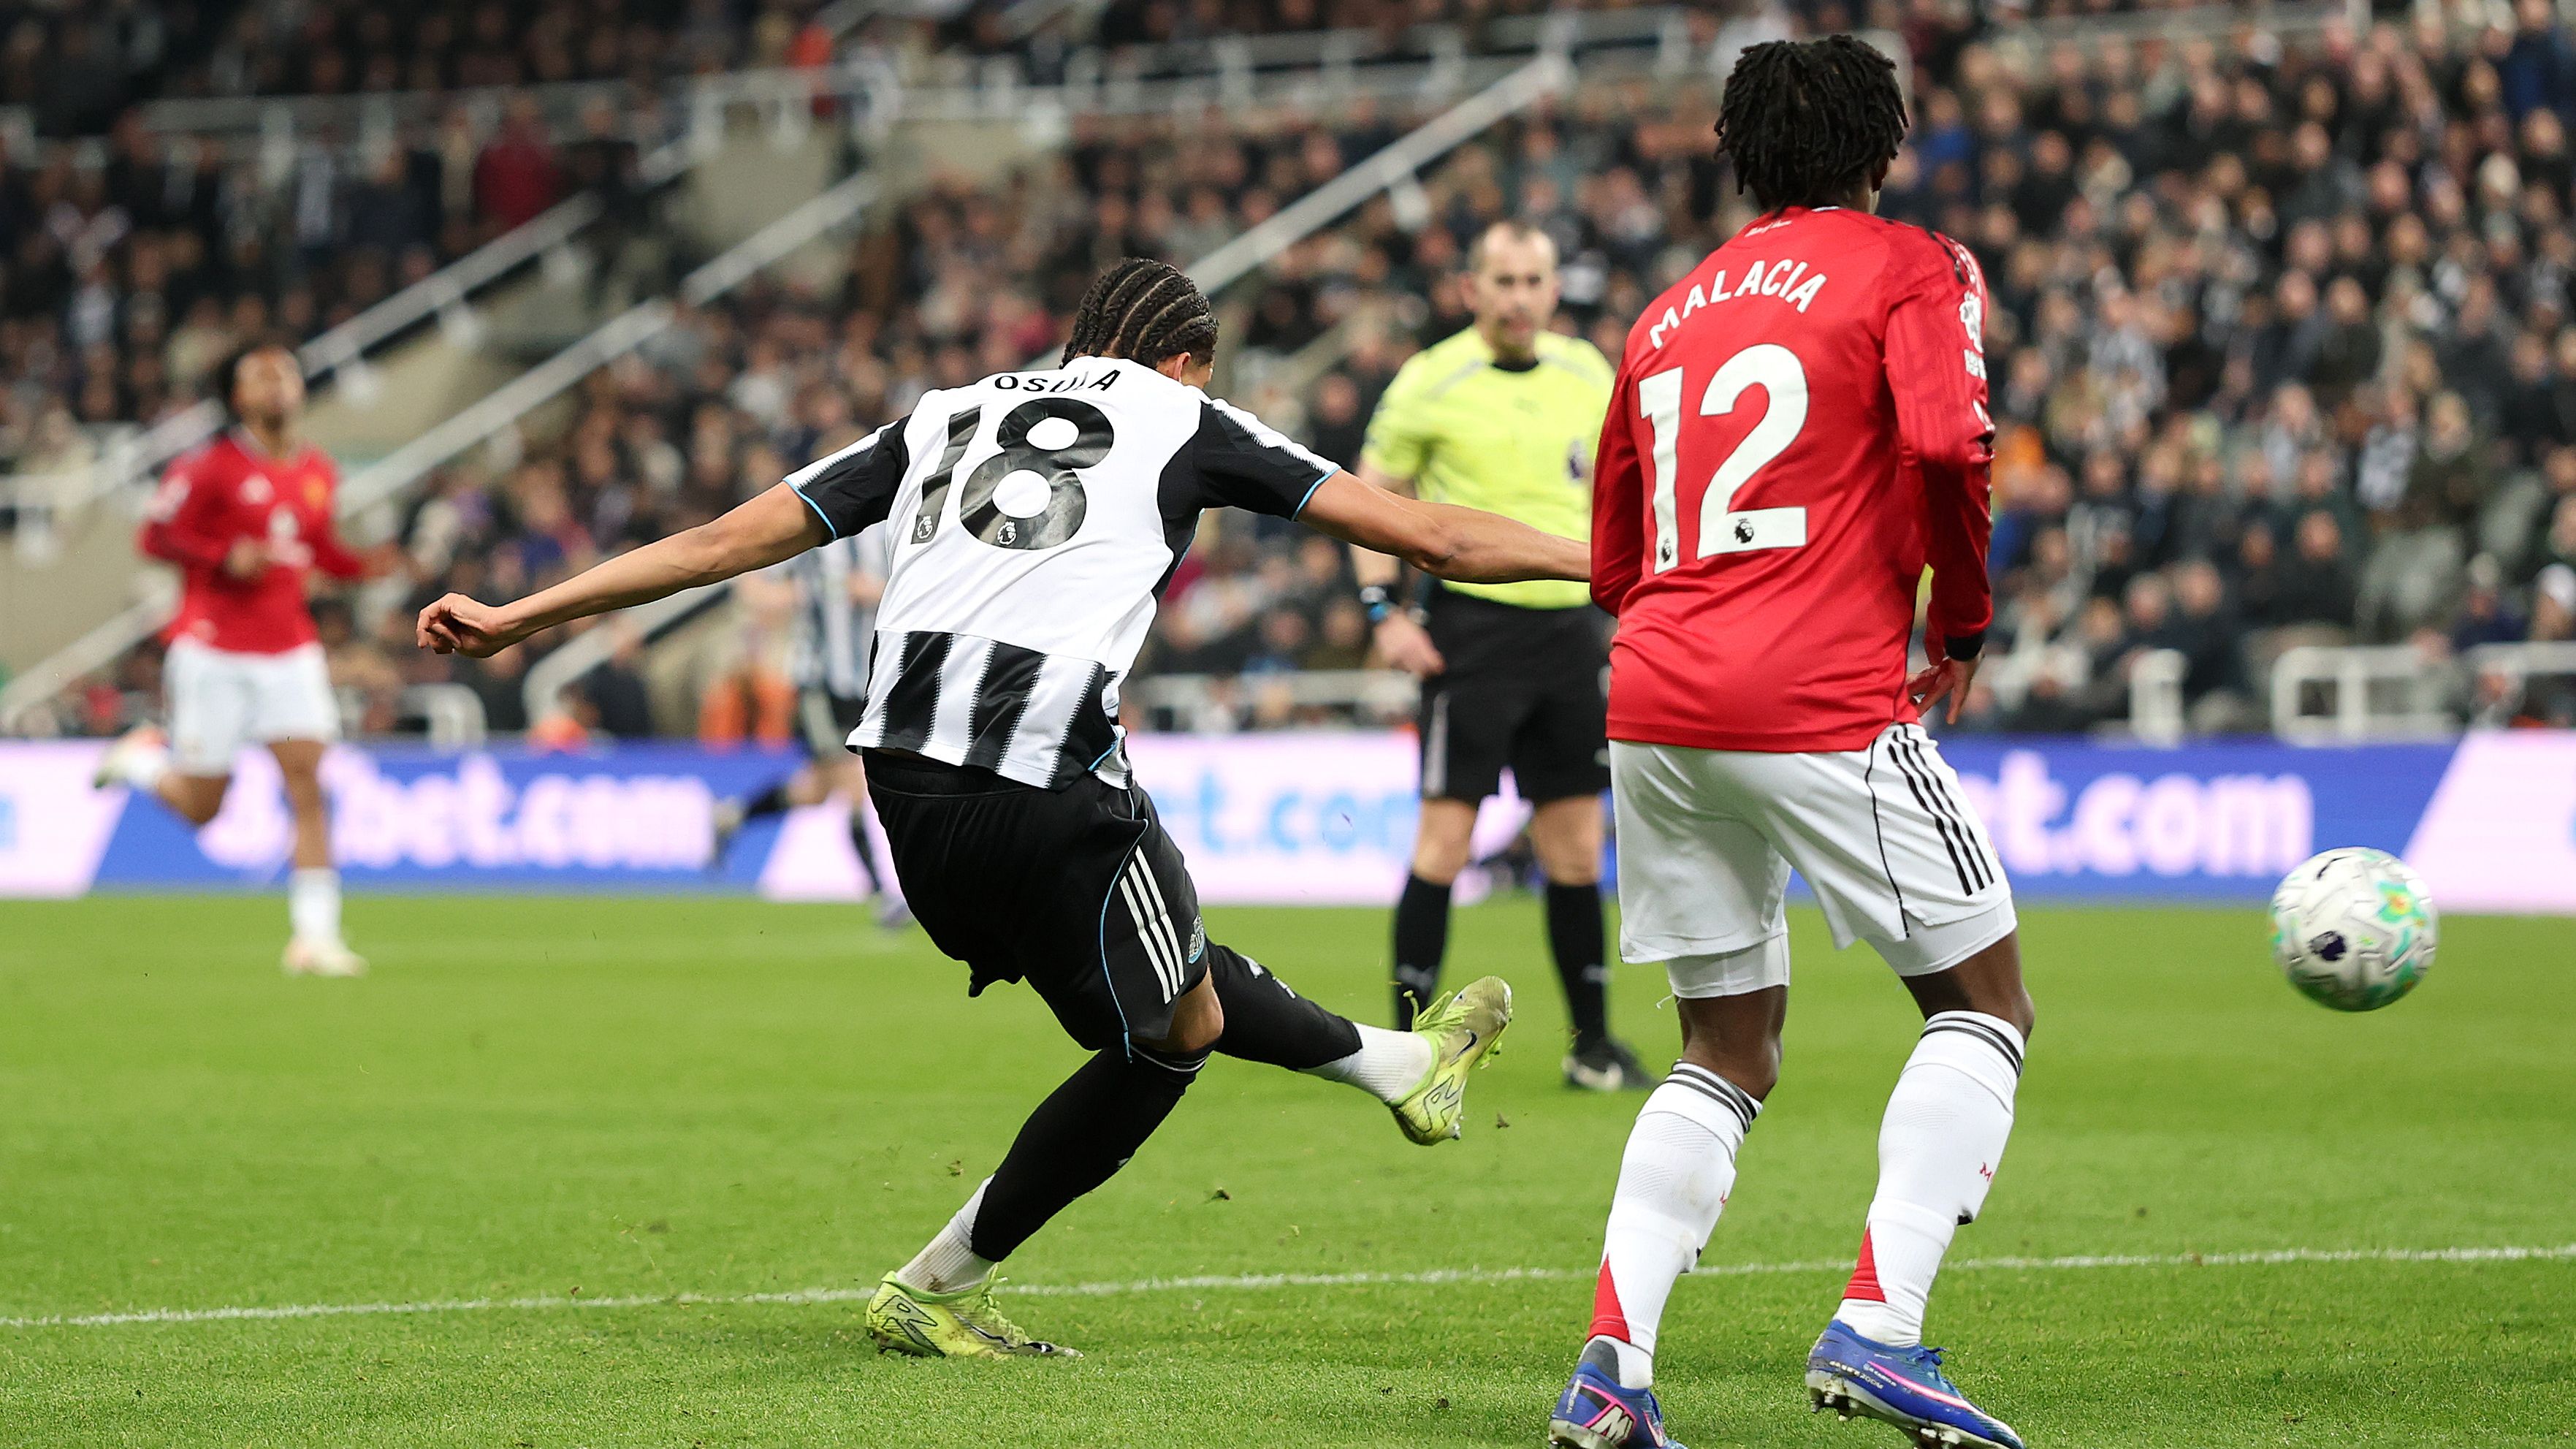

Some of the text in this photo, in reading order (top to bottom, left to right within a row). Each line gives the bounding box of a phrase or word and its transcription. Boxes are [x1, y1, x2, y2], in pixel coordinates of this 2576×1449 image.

[1649, 259, 1827, 349] MALACIA
[910, 397, 1115, 550] 18
[1638, 343, 1809, 575] 12
